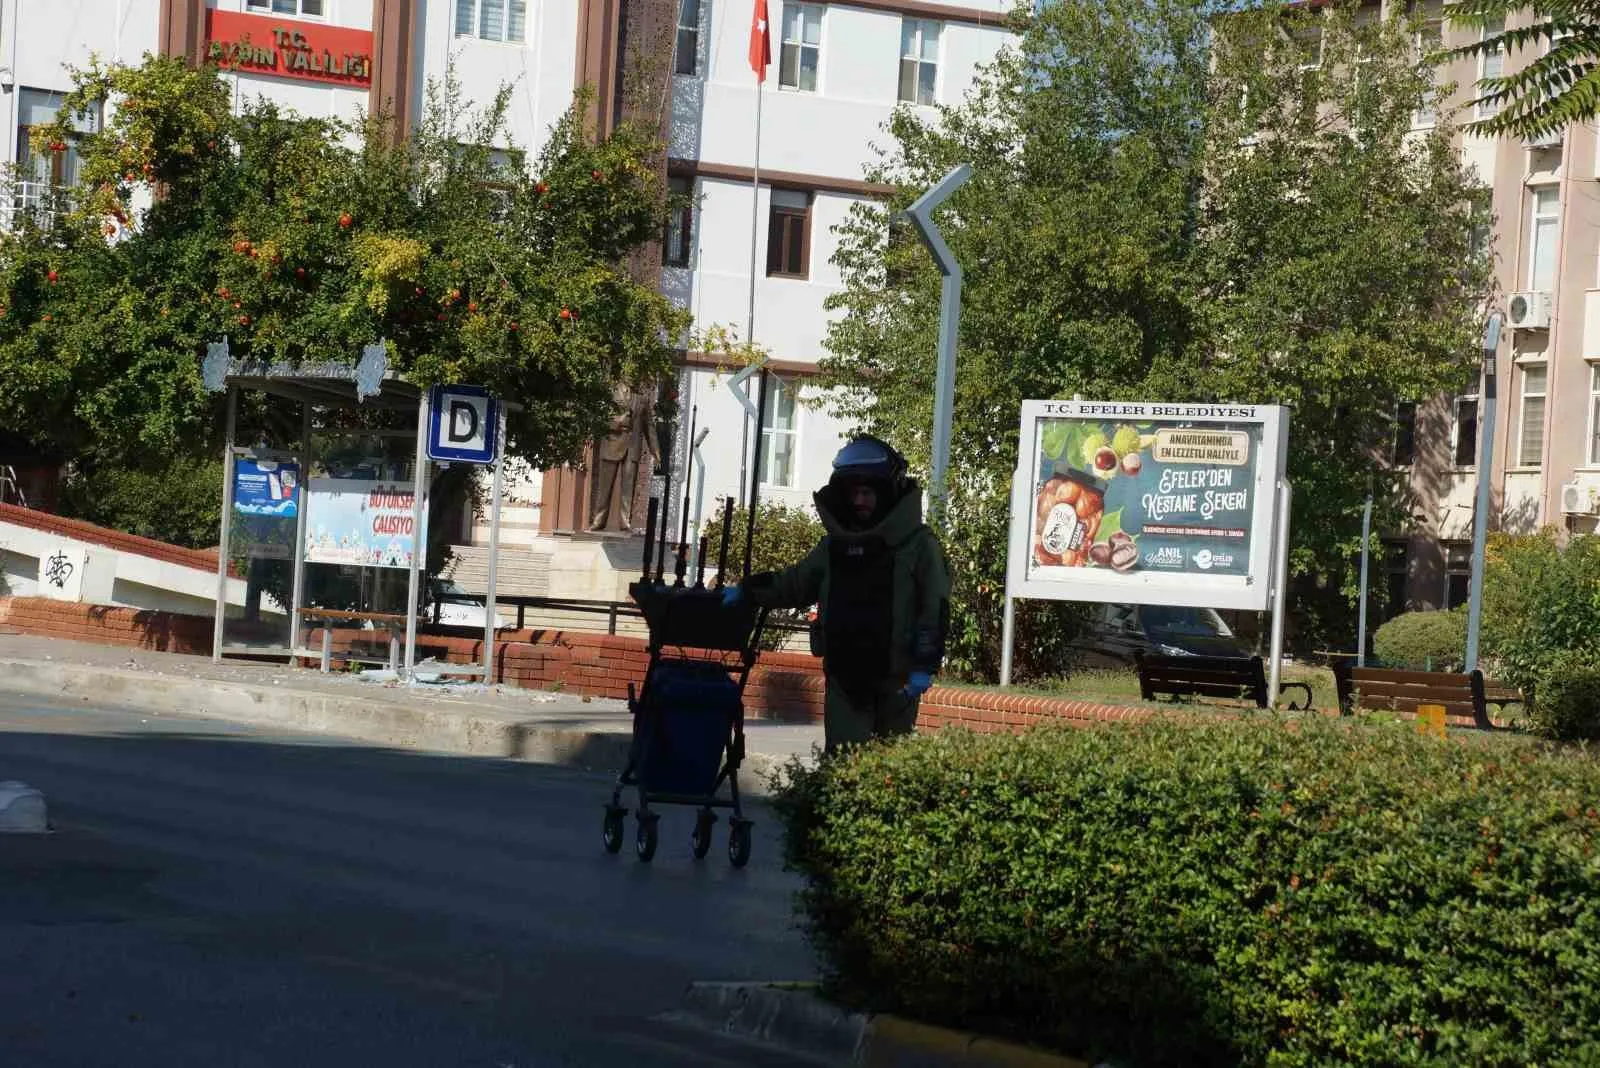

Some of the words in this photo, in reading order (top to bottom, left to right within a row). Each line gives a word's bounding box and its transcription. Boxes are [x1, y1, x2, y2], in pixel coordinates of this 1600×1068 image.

[272, 26, 310, 49] T.C.
[281, 48, 370, 78] VALİLİĞİ
[448, 400, 479, 443] D
[1044, 404, 1073, 414] T.C.
[1079, 405, 1145, 415] EFELER
[1151, 405, 1257, 417] BELEDİYESİ
[1169, 433, 1233, 447] ANAVATANINDA
[1160, 447, 1172, 458] EN
[1172, 447, 1206, 459] LEZZETLİ
[1206, 449, 1240, 460] HALİYLE
[1159, 468, 1233, 494] EFELER'DEN
[1142, 493, 1198, 521] KESTANE
[1200, 488, 1248, 520] ŞEKERİ
